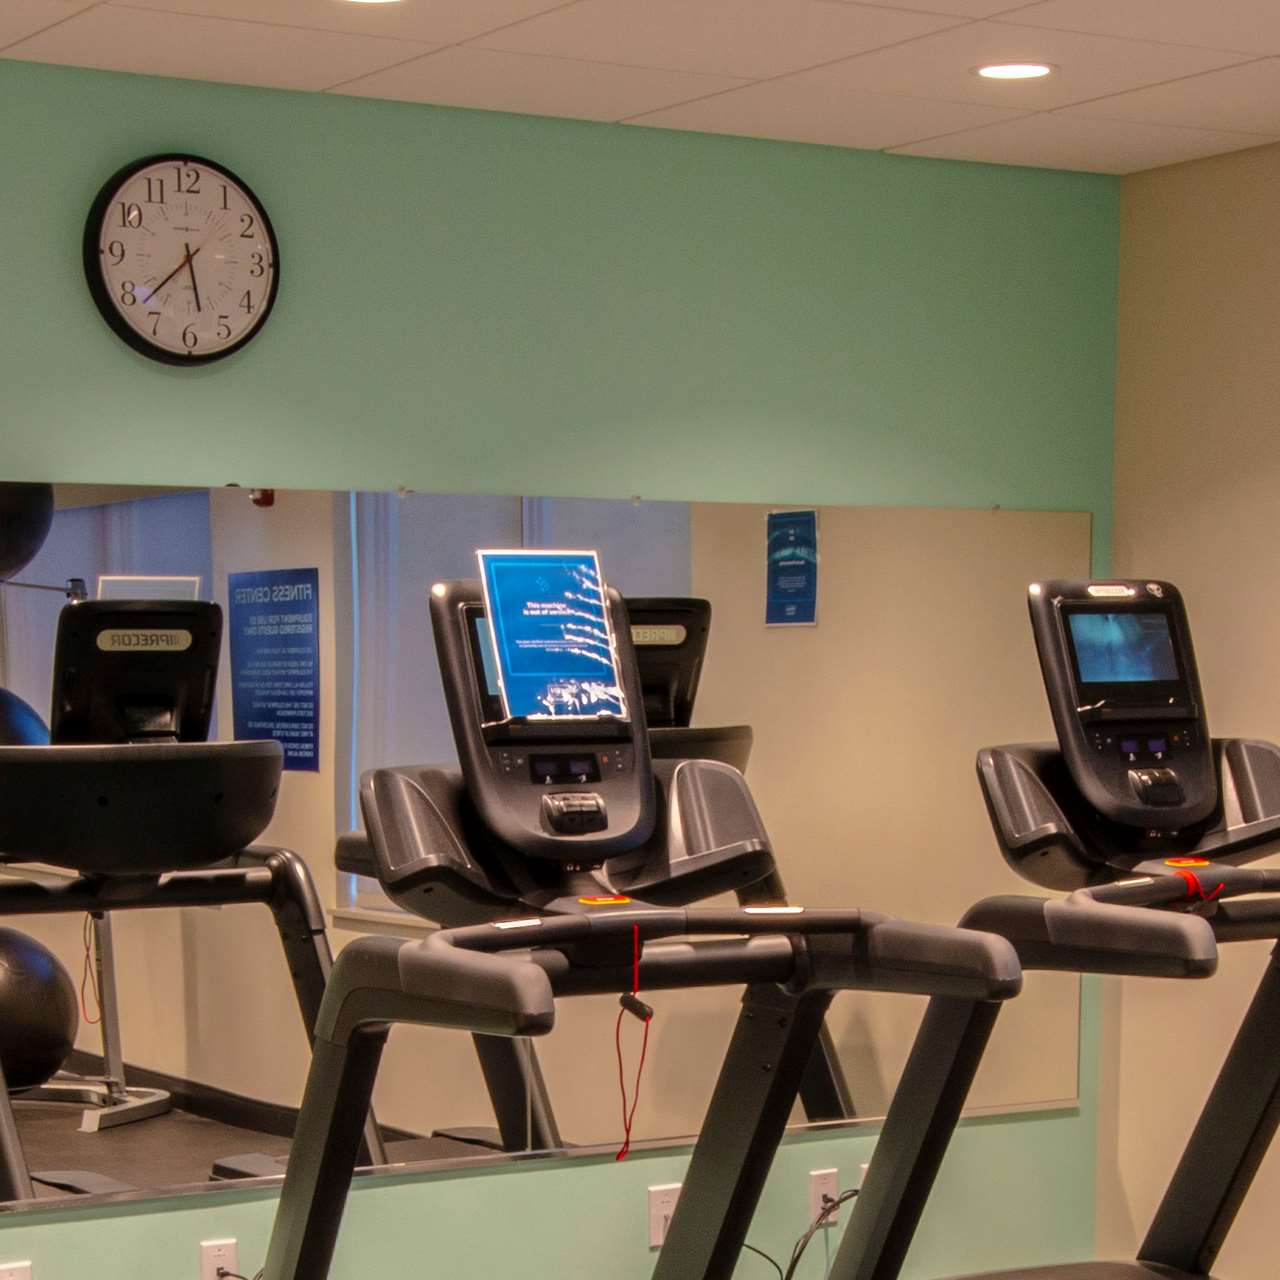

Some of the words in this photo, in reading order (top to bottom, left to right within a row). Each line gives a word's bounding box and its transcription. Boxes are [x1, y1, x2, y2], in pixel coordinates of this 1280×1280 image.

[144, 177, 167, 204] 11
[173, 166, 201, 194] 12
[220, 184, 232, 211] 1
[116, 201, 143, 229] 10
[239, 213, 255, 239] 2
[108, 240, 125, 266] 9
[249, 253, 265, 278] 3
[121, 280, 137, 306] 8
[239, 289, 255, 314] 4
[147, 311, 162, 336] 7
[182, 323, 198, 348] 6
[216, 315, 232, 339] 5
